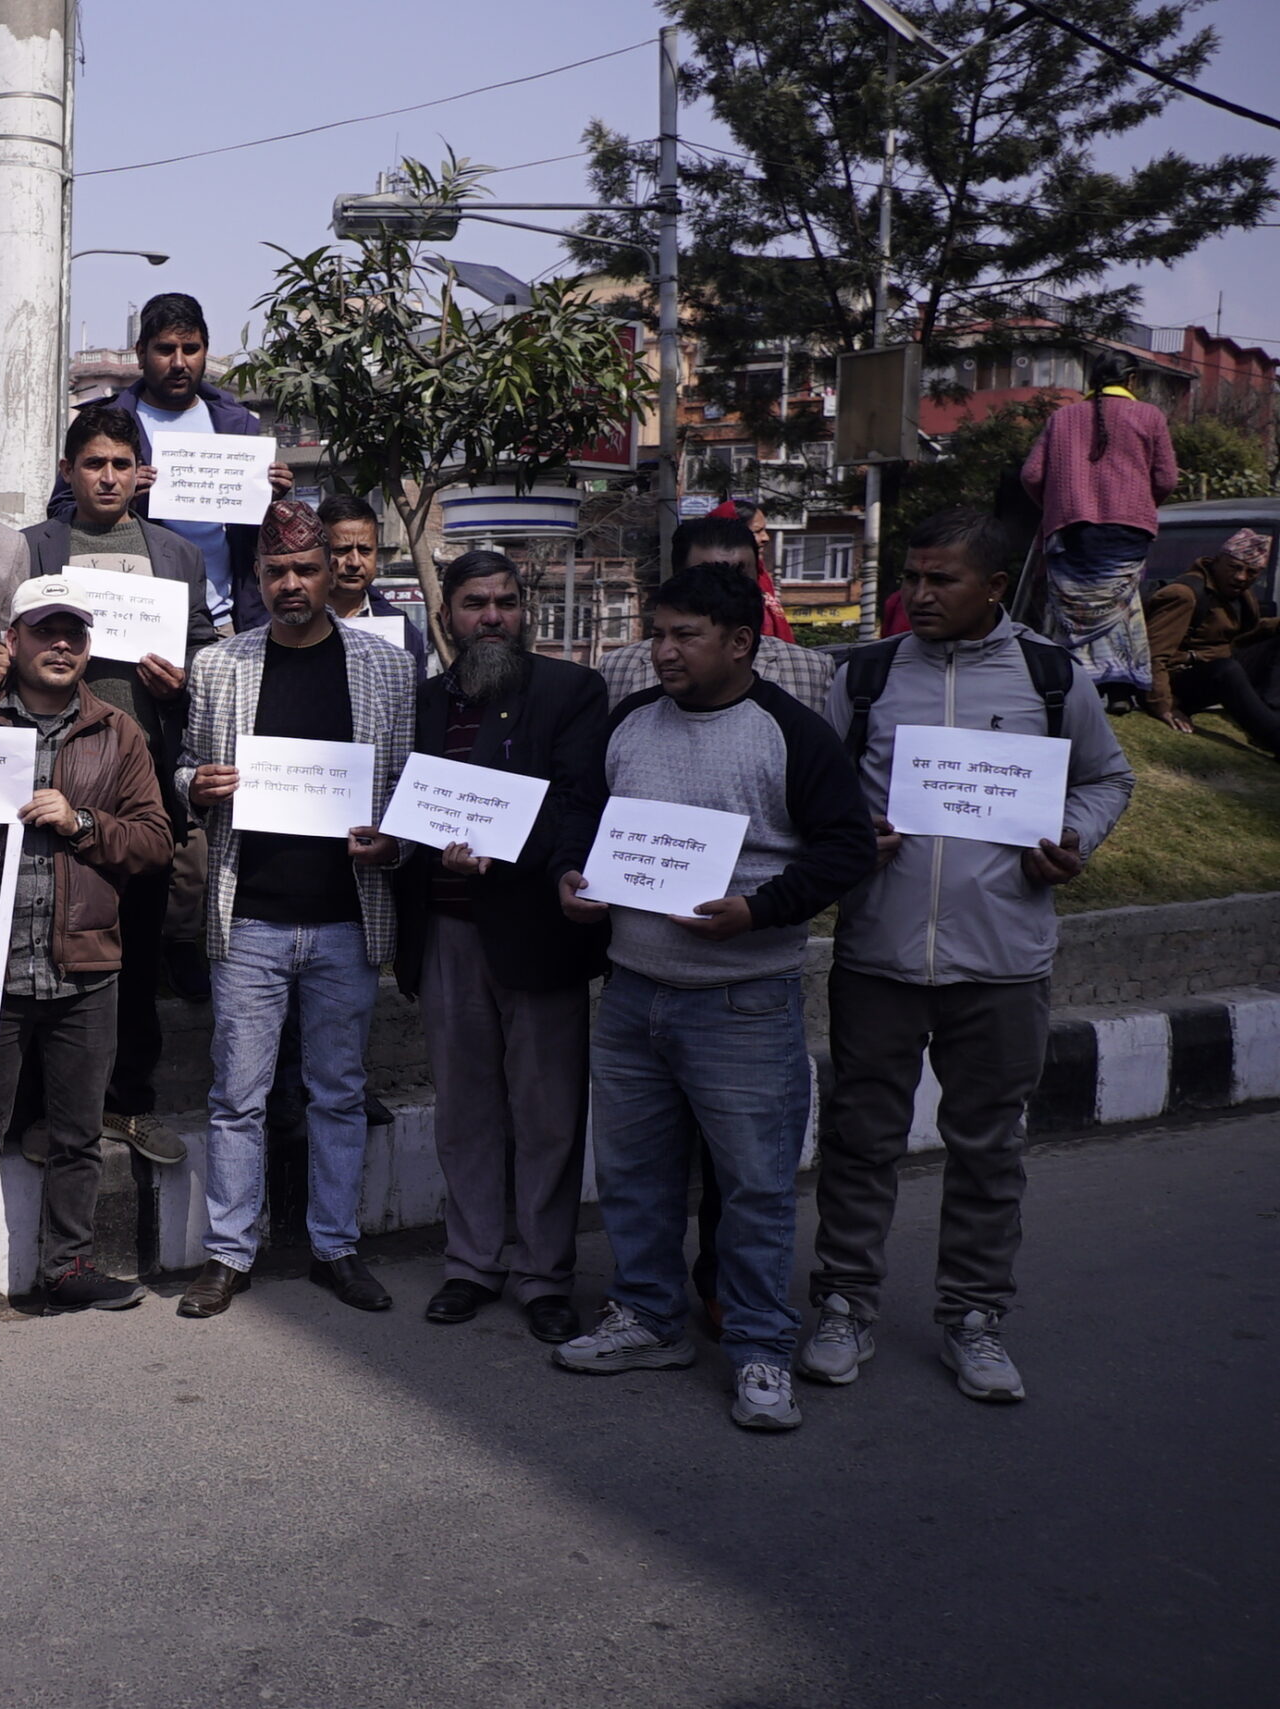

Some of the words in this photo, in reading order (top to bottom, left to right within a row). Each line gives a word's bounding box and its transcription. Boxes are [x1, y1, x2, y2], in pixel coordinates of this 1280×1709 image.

[162, 449, 196, 458] सामाजिक
[286, 765, 324, 776] हकमाथि
[329, 768, 348, 778] घात
[912, 757, 931, 768] प्रेस
[937, 760, 961, 770] तथा
[967, 761, 1032, 779] अभिव्यक्ति
[264, 780, 300, 792] विधेयक
[304, 783, 327, 794] फिर्ता
[413, 779, 428, 791] प्रेस
[433, 787, 453, 798] तथा
[456, 792, 510, 809] अभिव्यक्ति
[922, 779, 977, 793] स्वतन्त्रता
[984, 784, 1018, 797] खोस्न
[417, 800, 461, 818] स्वतन्त्रता
[466, 812, 493, 824] खोस्न
[610, 827, 624, 839] प्रेस
[628, 832, 647, 842] तथा
[650, 834, 707, 853] अभिव्यक्ति
[612, 850, 656, 865] स्वतन्त्रता
[661, 856, 690, 871] खोस्न
